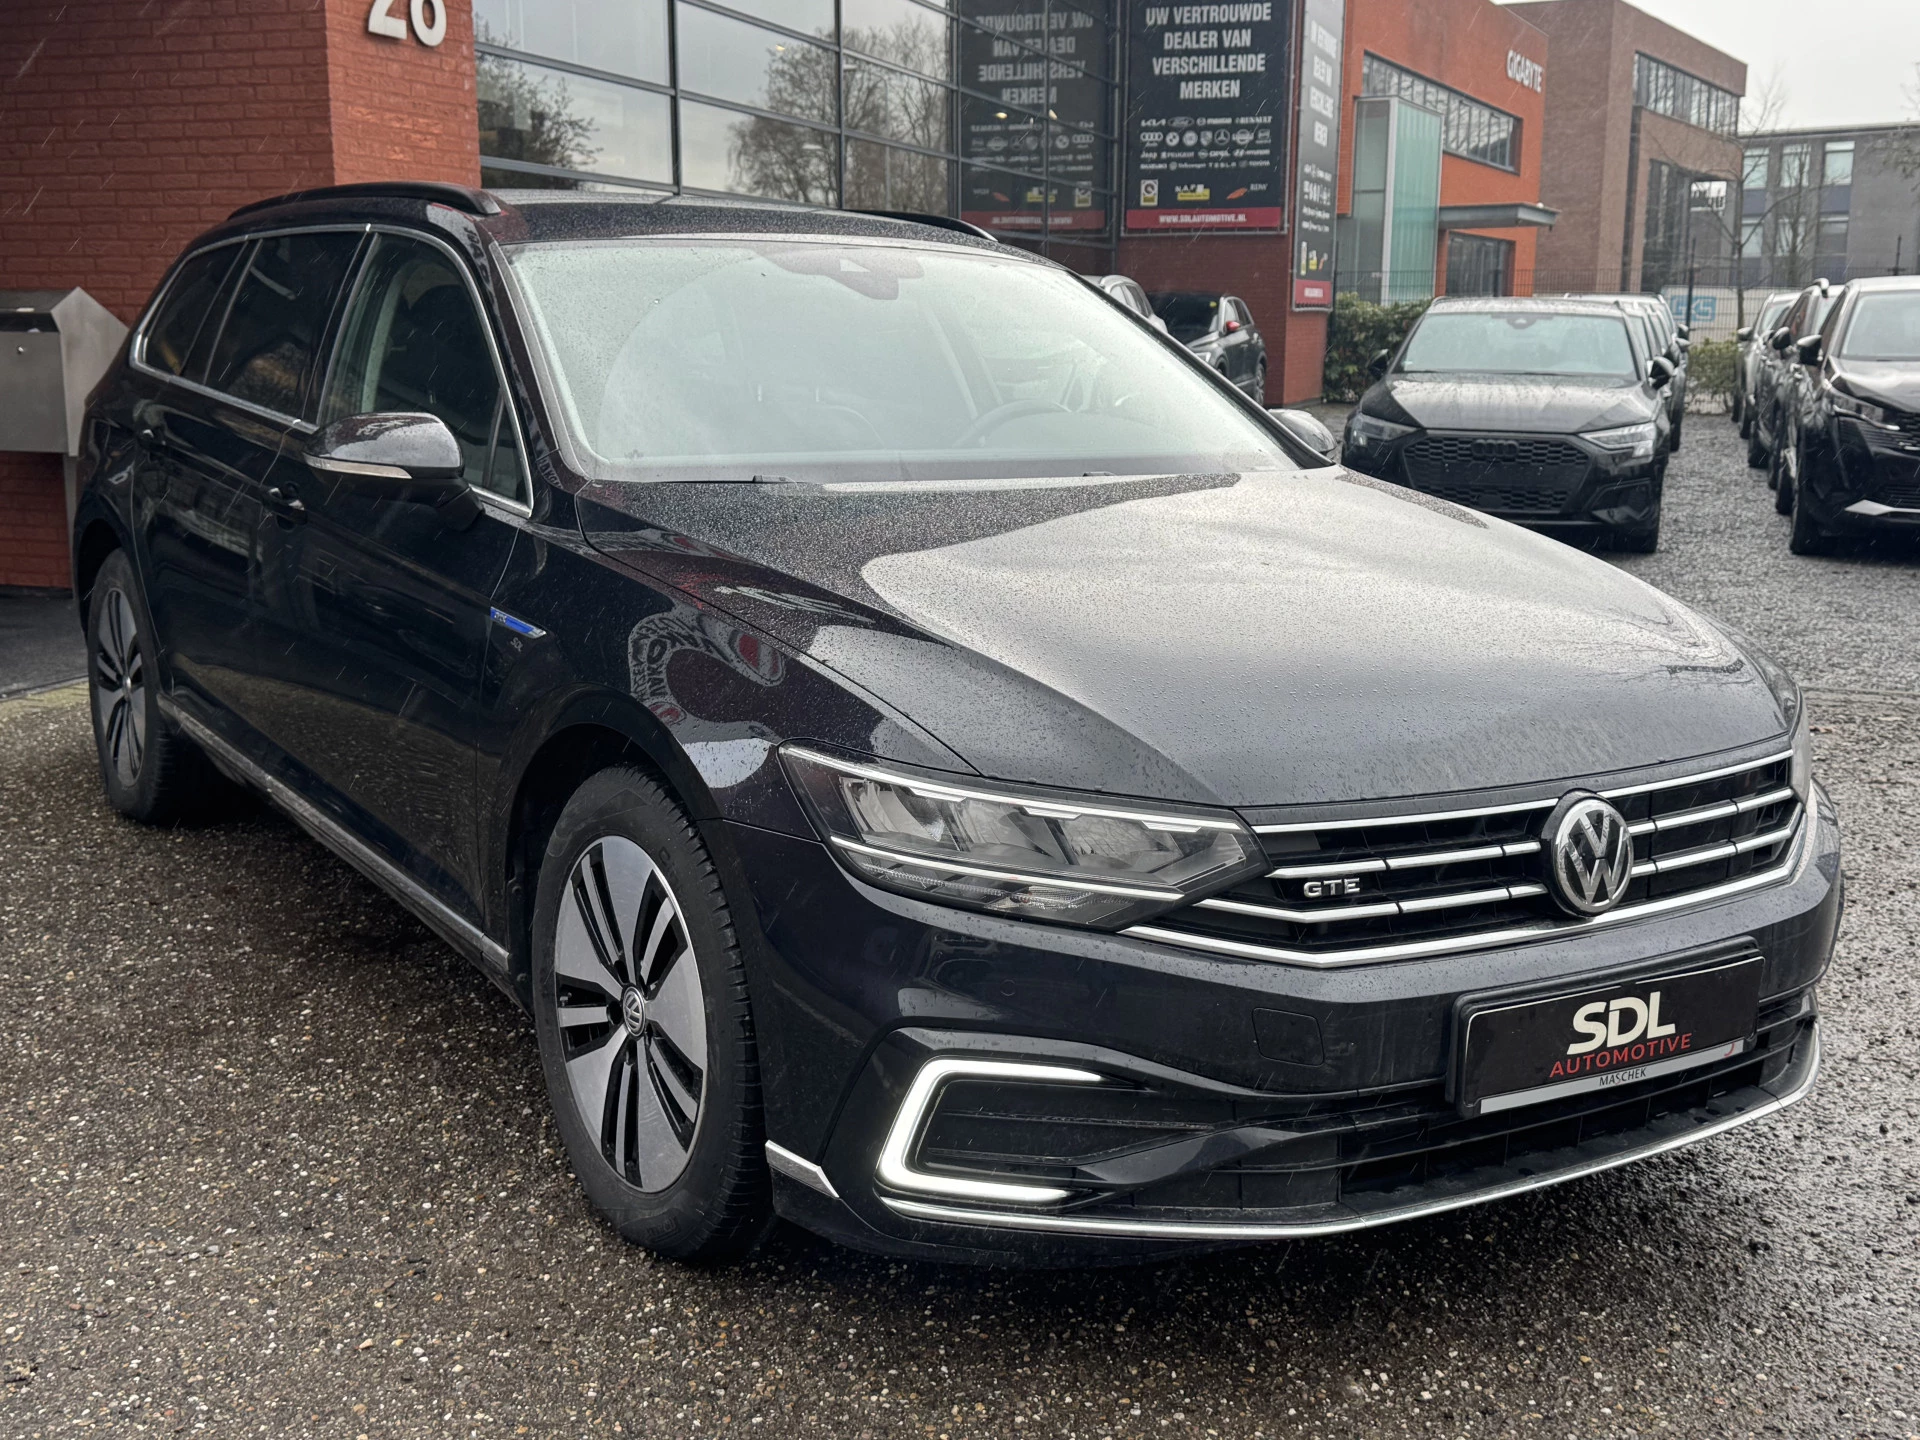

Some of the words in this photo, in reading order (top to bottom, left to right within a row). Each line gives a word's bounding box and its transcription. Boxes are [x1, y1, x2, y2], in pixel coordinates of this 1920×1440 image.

[1145, 7, 1170, 26] UW
[1173, 3, 1272, 25] VERTROUWDE
[1163, 30, 1218, 50] DEALER
[1222, 28, 1251, 48] VAN
[1152, 53, 1266, 76] VERSCHILLENDE
[1180, 79, 1241, 100] MERKEN
[1303, 877, 1361, 899] GTE
[1566, 991, 1676, 1055] SDL
[1549, 1033, 1692, 1078] AUTOMOTIVE
[1599, 1066, 1647, 1087] MASCHEK
